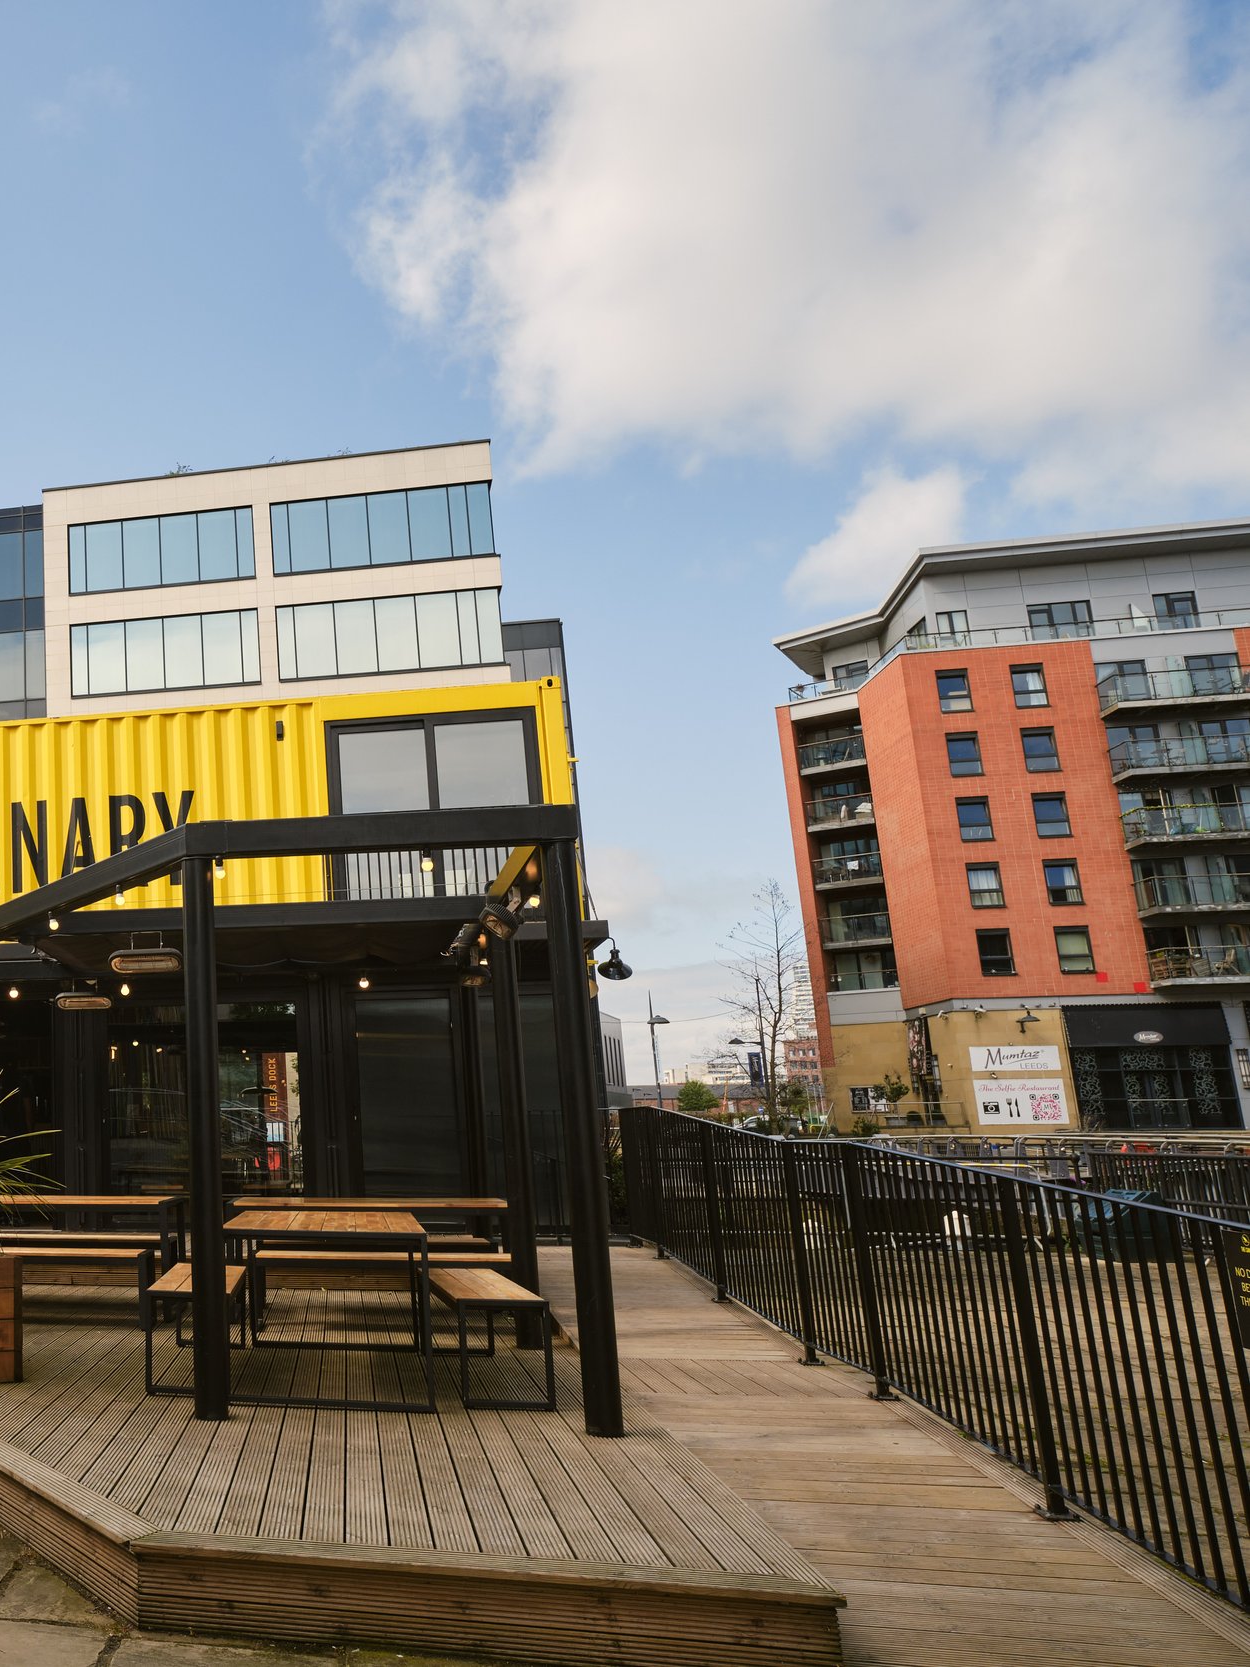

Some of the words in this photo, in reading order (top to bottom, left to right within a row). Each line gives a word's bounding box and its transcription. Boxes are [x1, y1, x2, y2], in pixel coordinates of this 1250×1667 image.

[984, 1048, 1040, 1069] Mumtaz
[268, 1058, 277, 1081] DOCK
[978, 1084, 993, 1092] The
[995, 1084, 1016, 1092] Selfie
[1017, 1084, 1060, 1092] Restaurant
